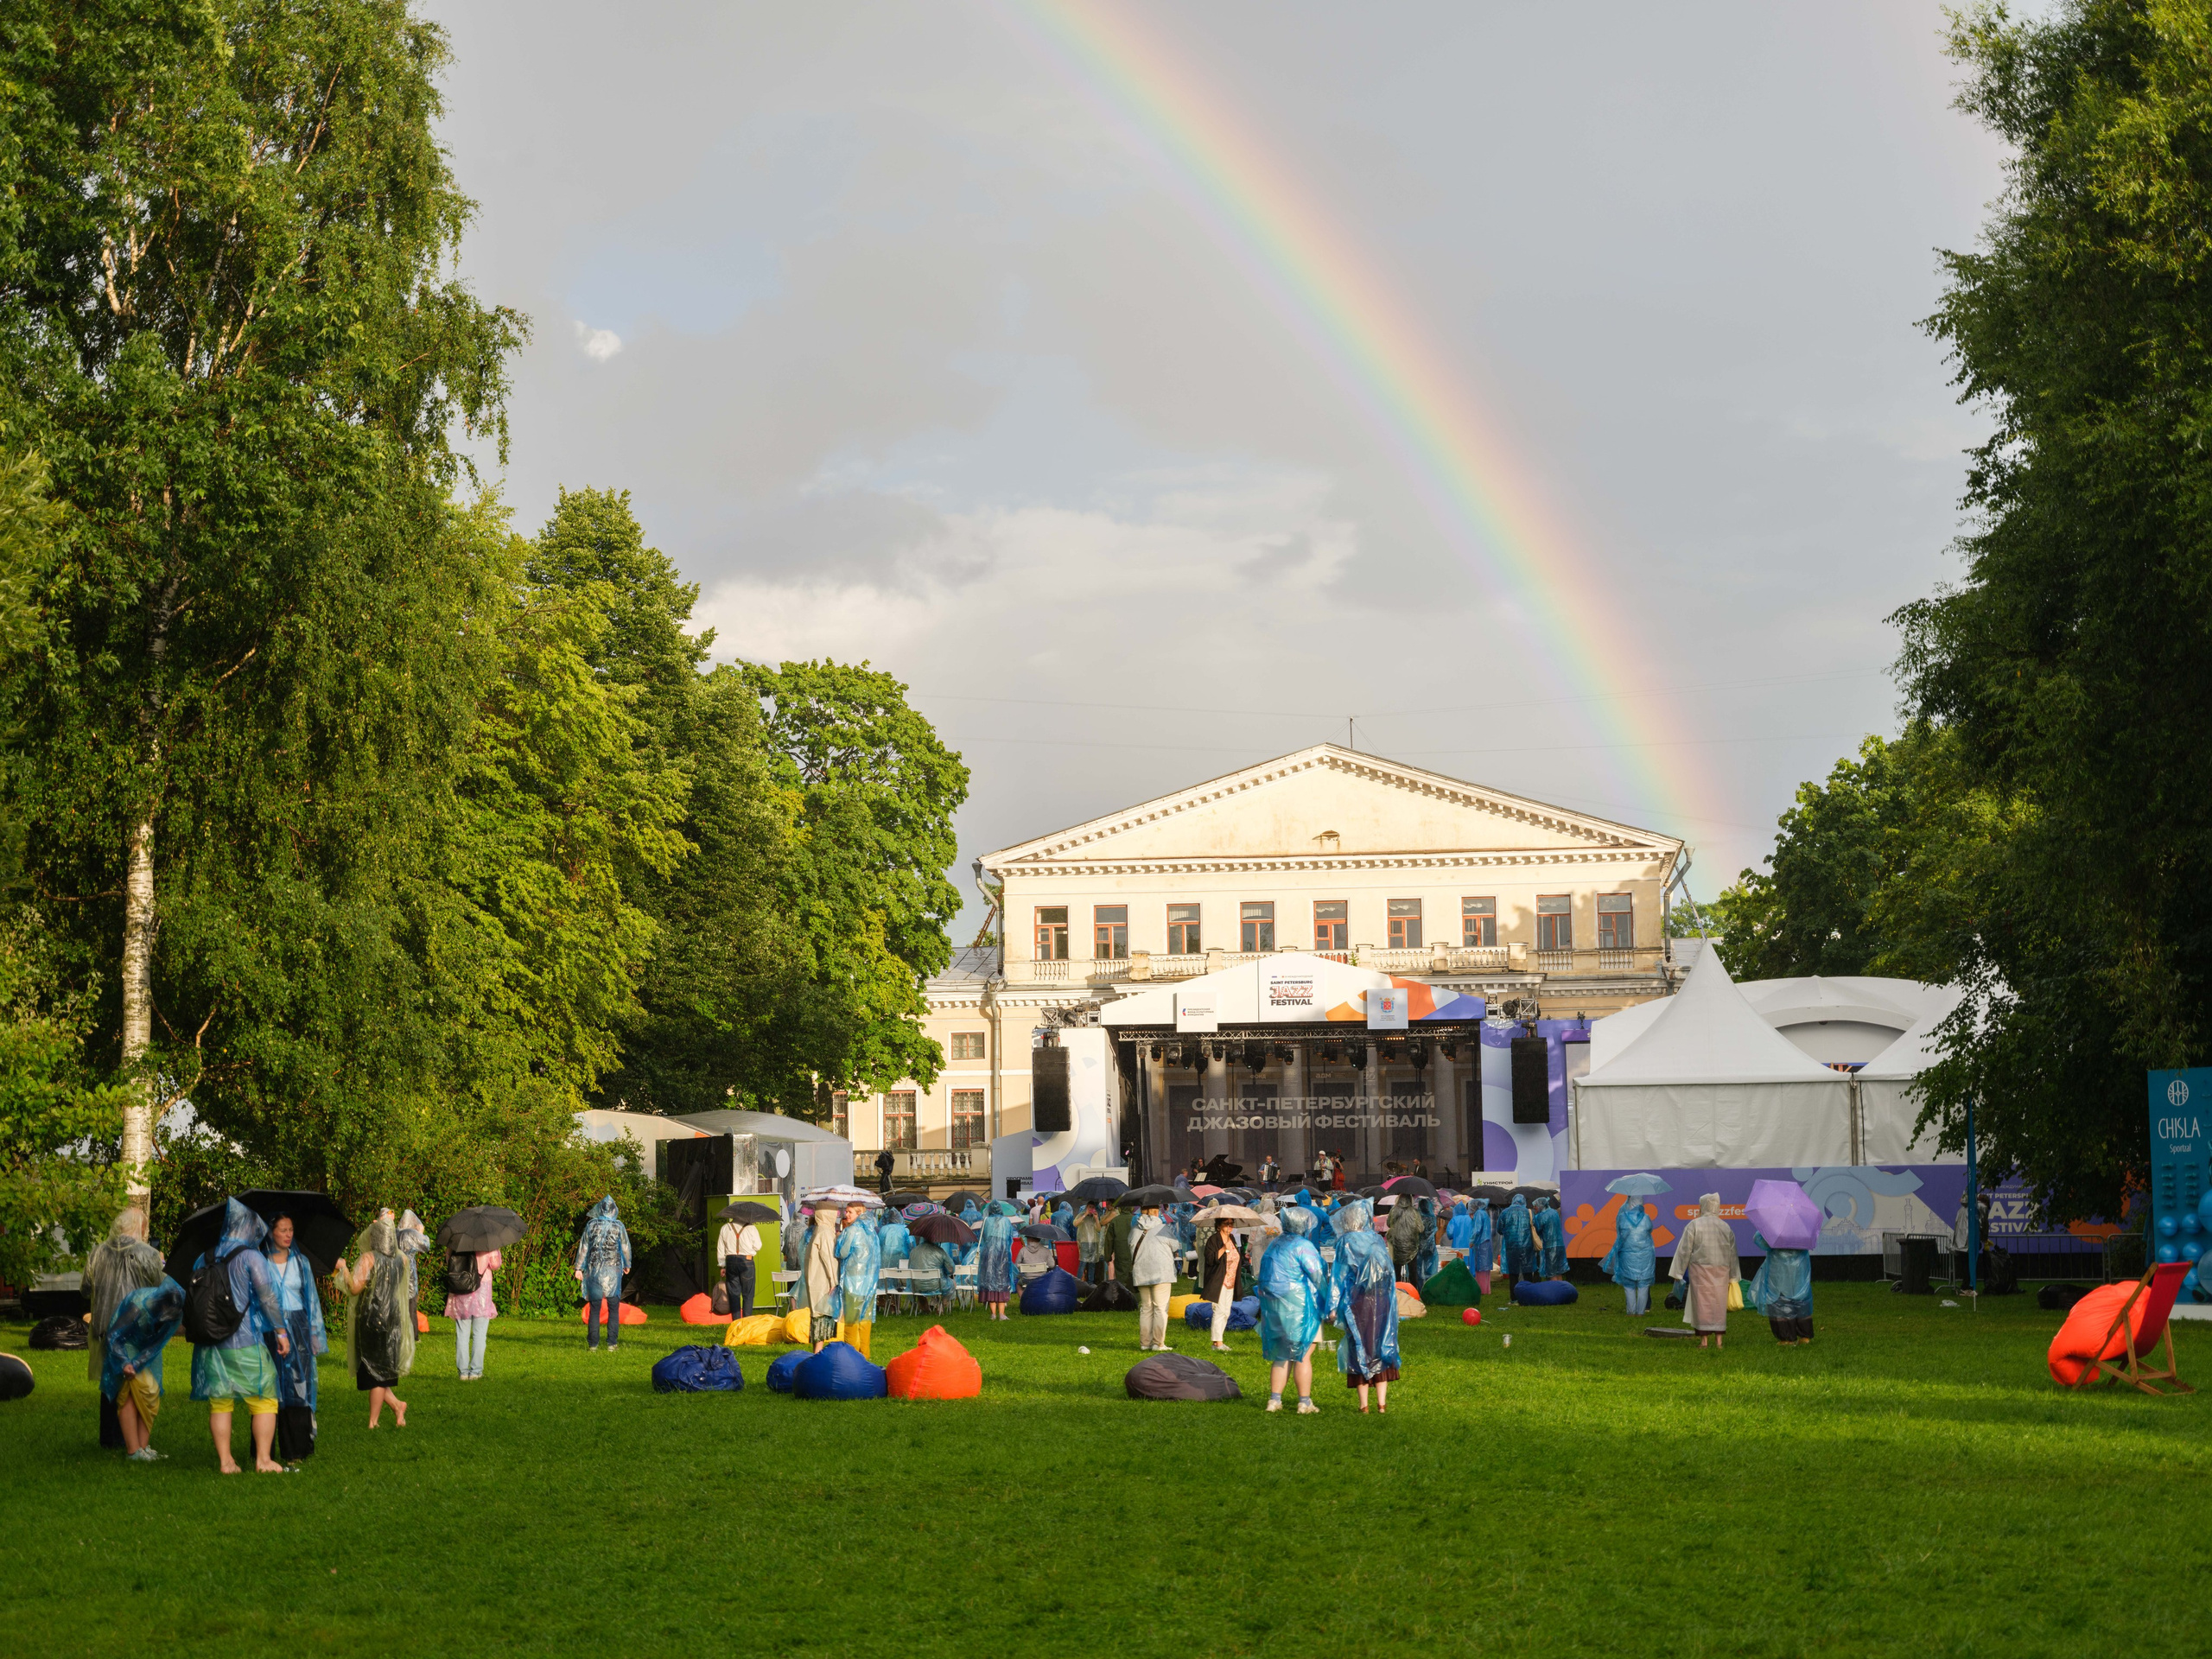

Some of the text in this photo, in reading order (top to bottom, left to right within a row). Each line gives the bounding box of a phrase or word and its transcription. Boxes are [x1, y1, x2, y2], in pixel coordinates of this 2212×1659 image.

[1268, 985, 1313, 998] JAZZ
[1192, 1091, 1435, 1111] САНКТ-ПЕТЕРБУРГСКИЙ
[1186, 1112, 1441, 1132] ДЖАЗОВЫЙ ФЕСТИВАЛЬ
[2158, 1116, 2201, 1139] CHISLA
[2169, 1143, 2192, 1154] Sportzal
